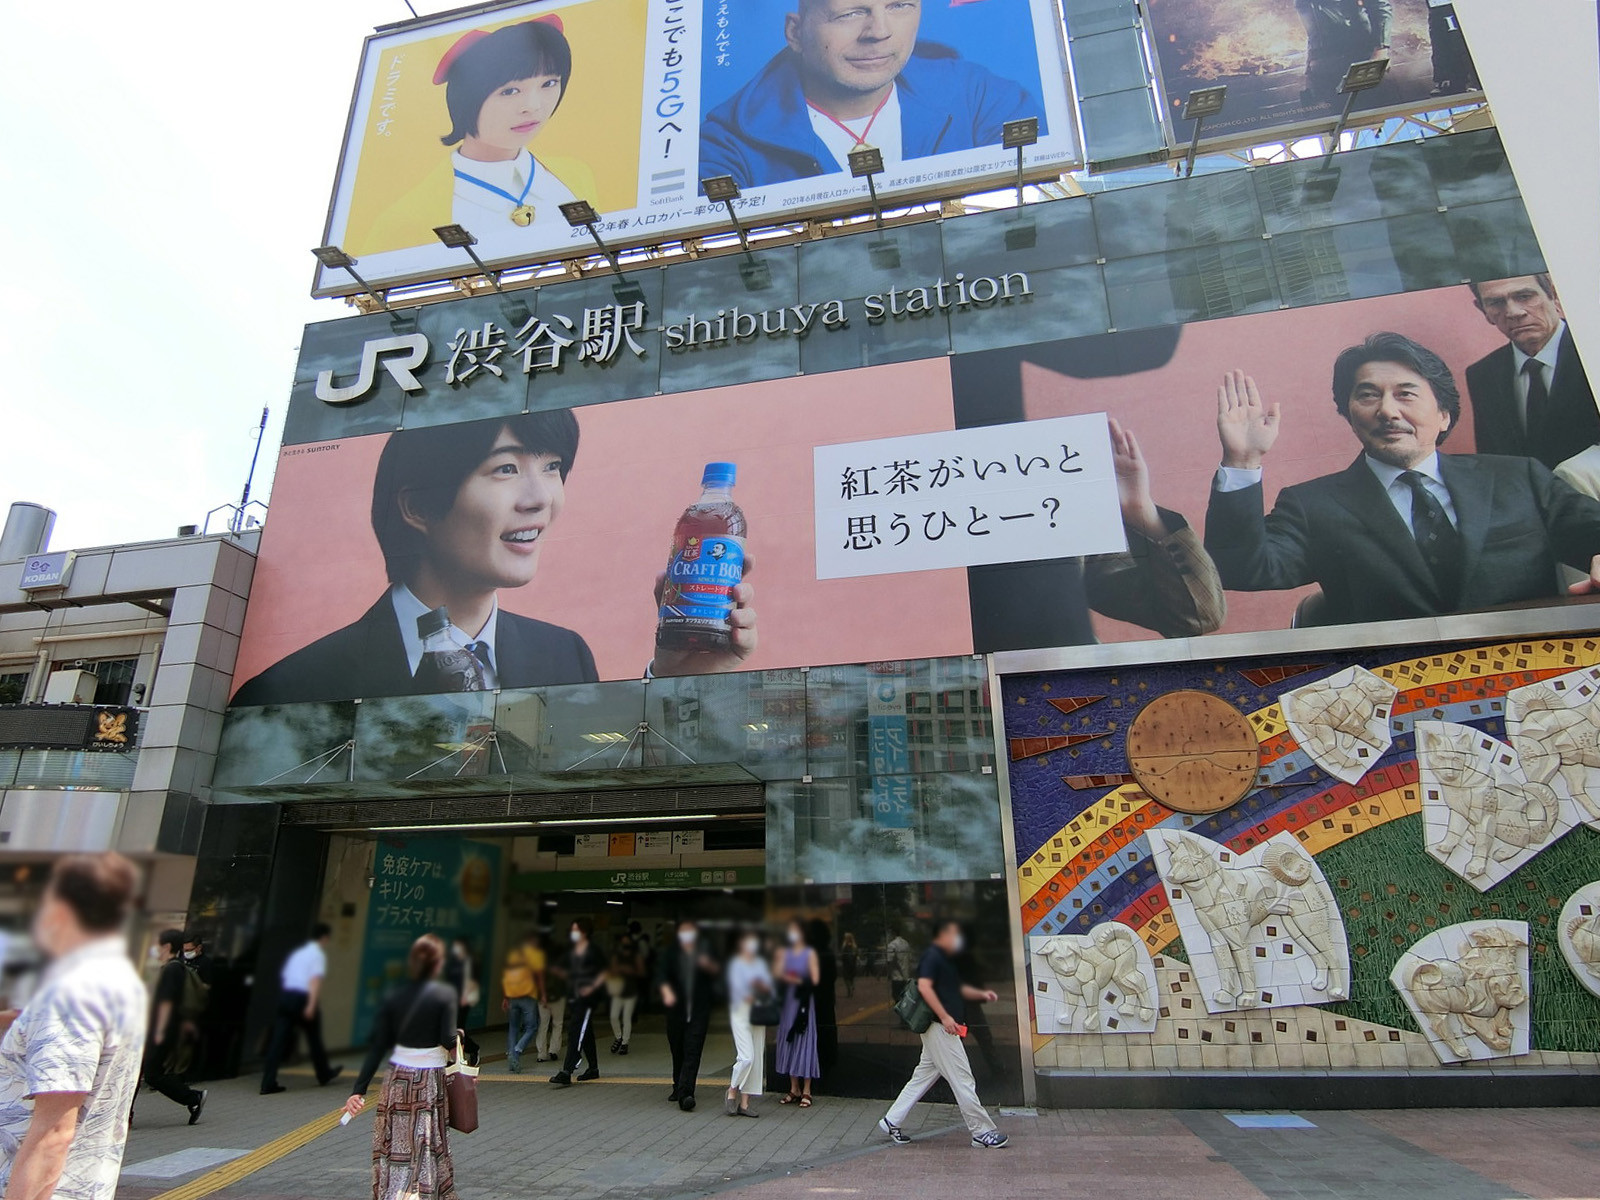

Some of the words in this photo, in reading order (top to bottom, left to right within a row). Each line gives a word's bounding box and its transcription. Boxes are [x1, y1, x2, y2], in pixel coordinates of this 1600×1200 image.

[715, 0, 730, 67] えもんです。
[656, 0, 687, 159] こでも5Gへ！
[376, 53, 406, 136] ドラミです。
[649, 194, 684, 206] SoftBank
[315, 332, 429, 403] JR
[444, 299, 646, 385] 渋谷駅
[665, 298, 850, 350] shibuya
[864, 270, 1034, 319] station
[306, 444, 341, 454] SUNTORY
[840, 443, 1083, 501] 紅茶がいいと
[842, 497, 1060, 551] 思うひとー？
[683, 548, 699, 558] 紅茶
[24, 572, 60, 583] KOBAN
[674, 561, 717, 576] CRAFT
[610, 872, 627, 883] JR
[378, 879, 425, 901] キリンの
[375, 904, 460, 929] プラズマ乳
